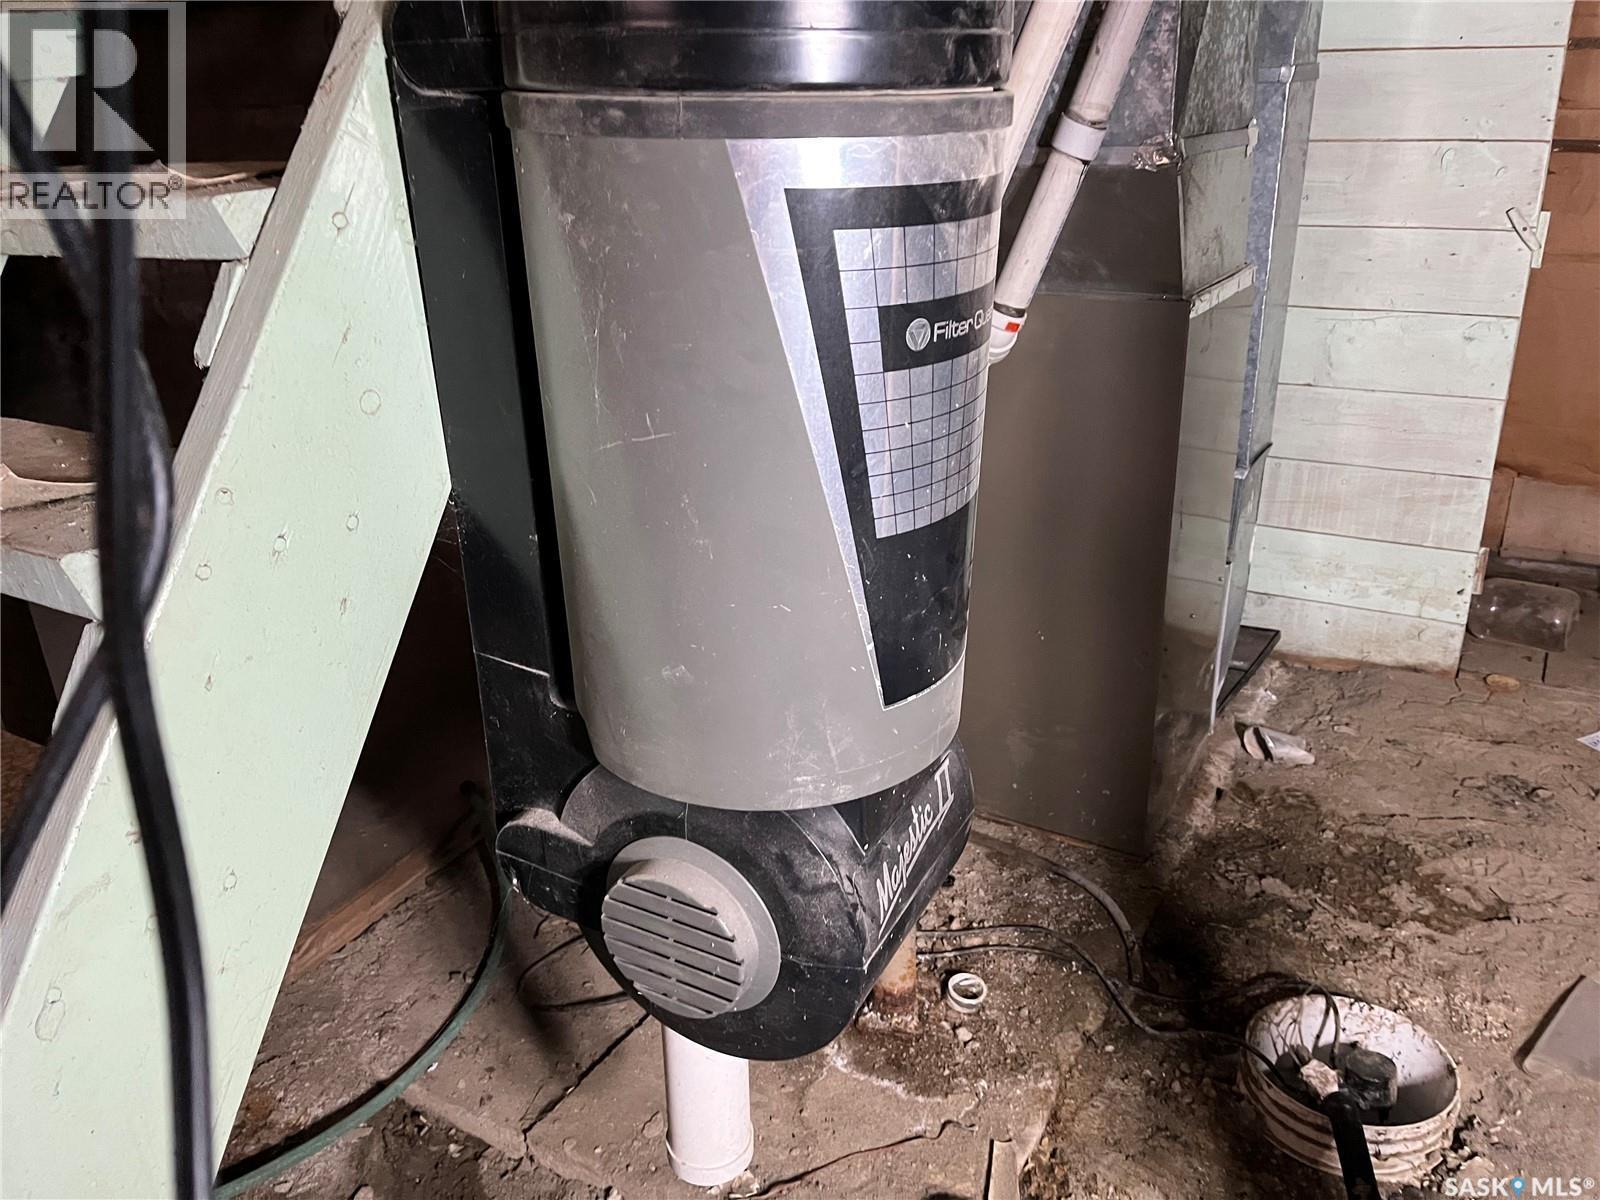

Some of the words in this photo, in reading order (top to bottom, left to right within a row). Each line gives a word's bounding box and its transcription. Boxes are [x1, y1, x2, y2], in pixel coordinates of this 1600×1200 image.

[933, 318, 974, 343] Filter
[974, 306, 993, 330] Que
[876, 803, 934, 925] Majestic
[934, 757, 955, 816] II
